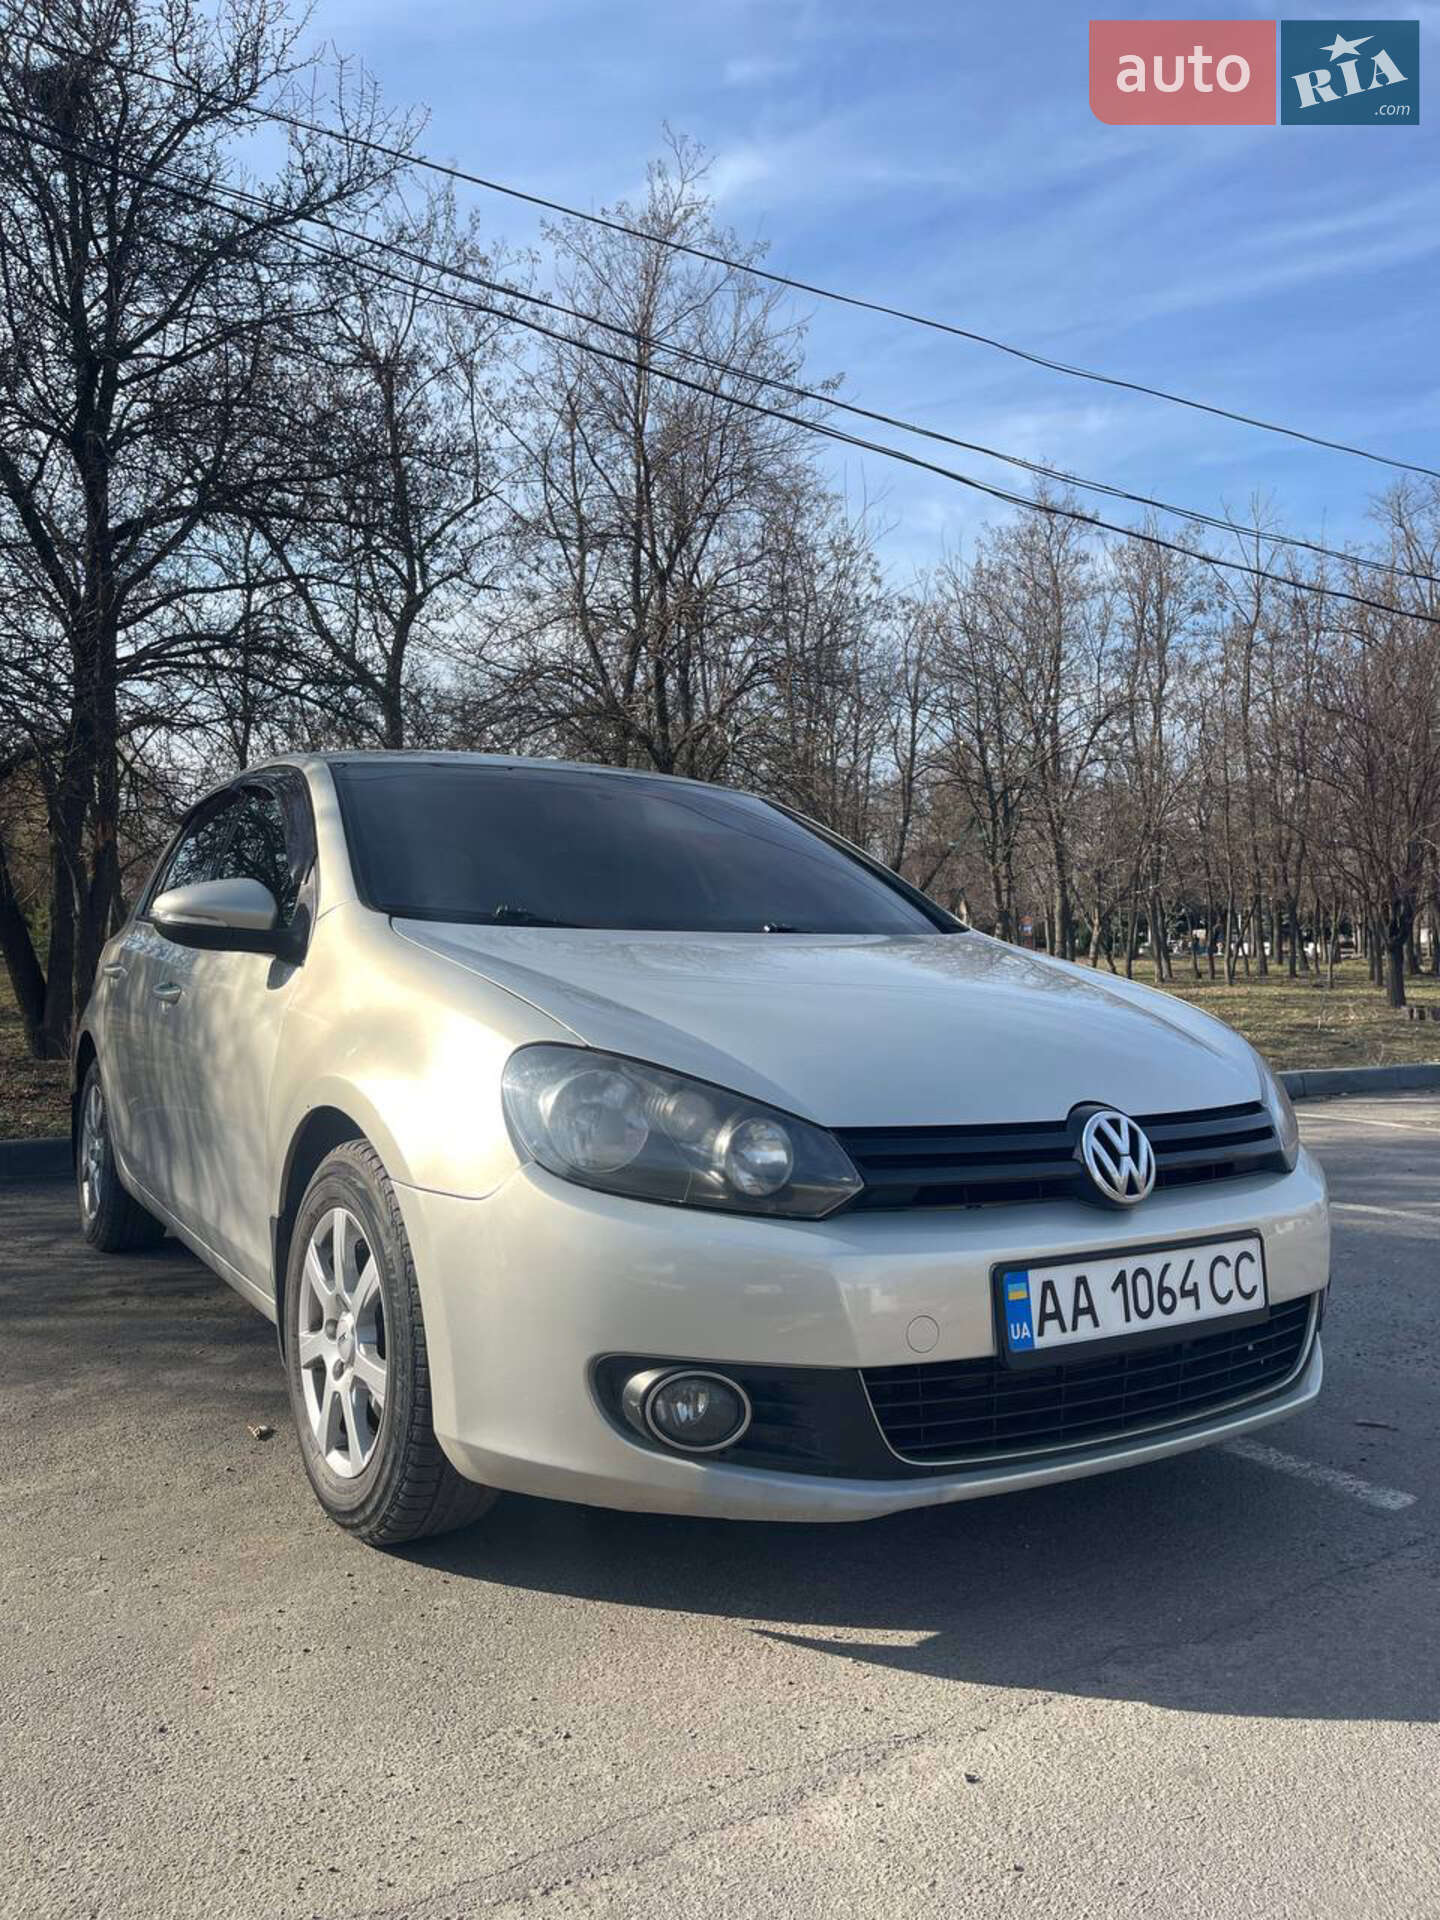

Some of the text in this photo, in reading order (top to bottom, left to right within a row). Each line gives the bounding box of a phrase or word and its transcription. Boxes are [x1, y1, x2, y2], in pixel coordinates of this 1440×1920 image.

[1037, 1250, 1258, 1337] AA 1064 CC
[1010, 1326, 1031, 1340] UA
